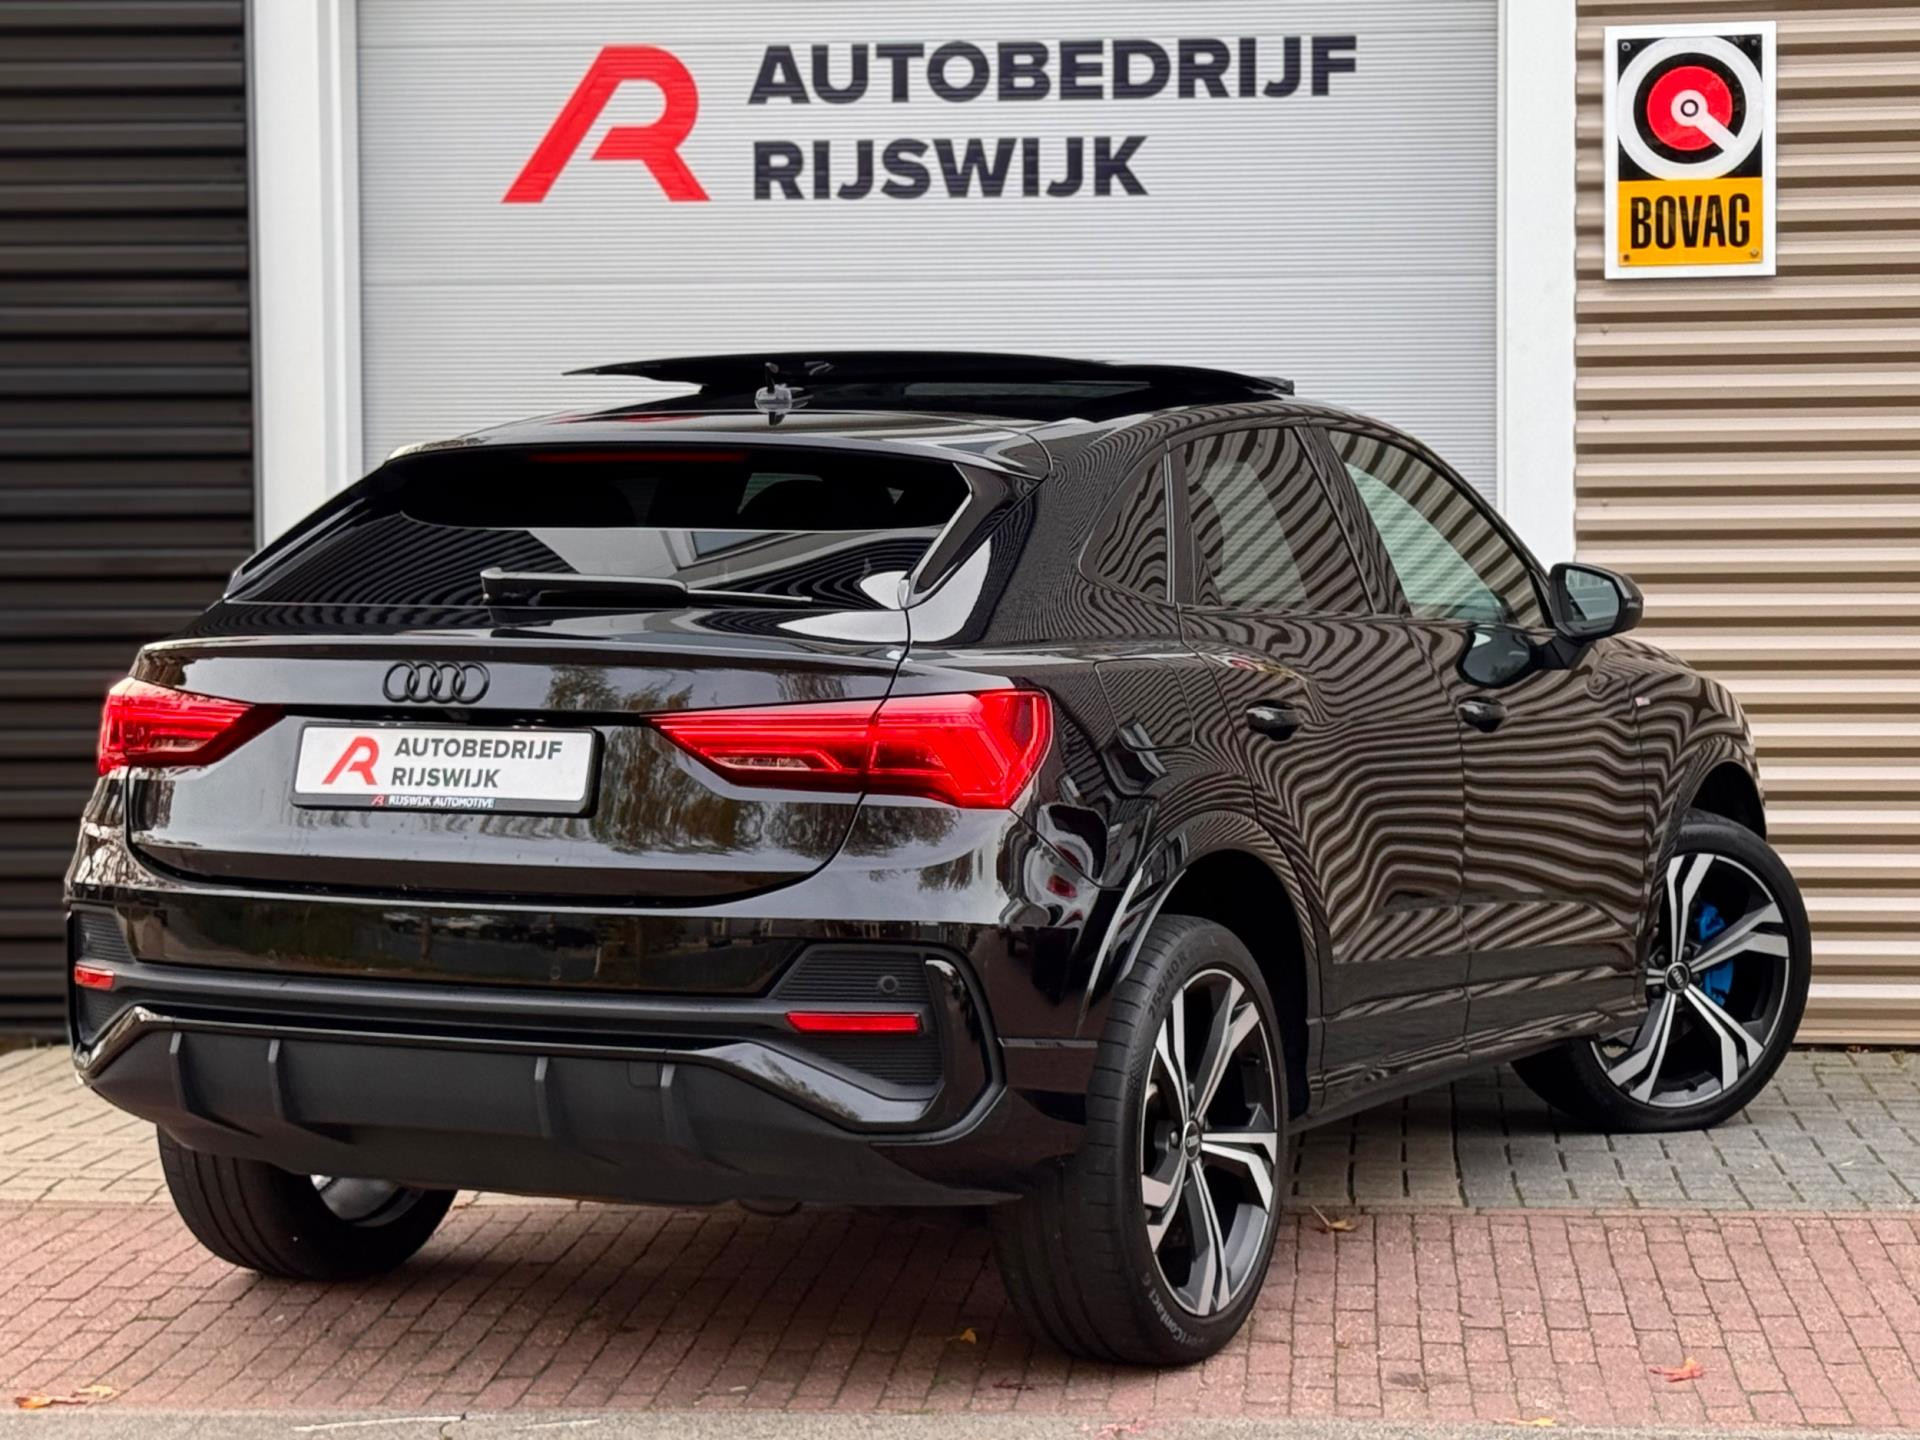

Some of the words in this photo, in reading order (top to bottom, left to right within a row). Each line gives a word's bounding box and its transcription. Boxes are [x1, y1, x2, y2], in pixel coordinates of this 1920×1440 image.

[748, 35, 1358, 105] AUTOBEDRIJF
[754, 136, 1147, 200] RIJSWIJK
[1630, 193, 1750, 250] BOVAG
[394, 737, 563, 760] AUTOBEDRIJF
[391, 767, 500, 788] RIJSWIJK
[388, 793, 433, 807] RIJSWIJK
[433, 794, 496, 809] AUTOMOTIVE
